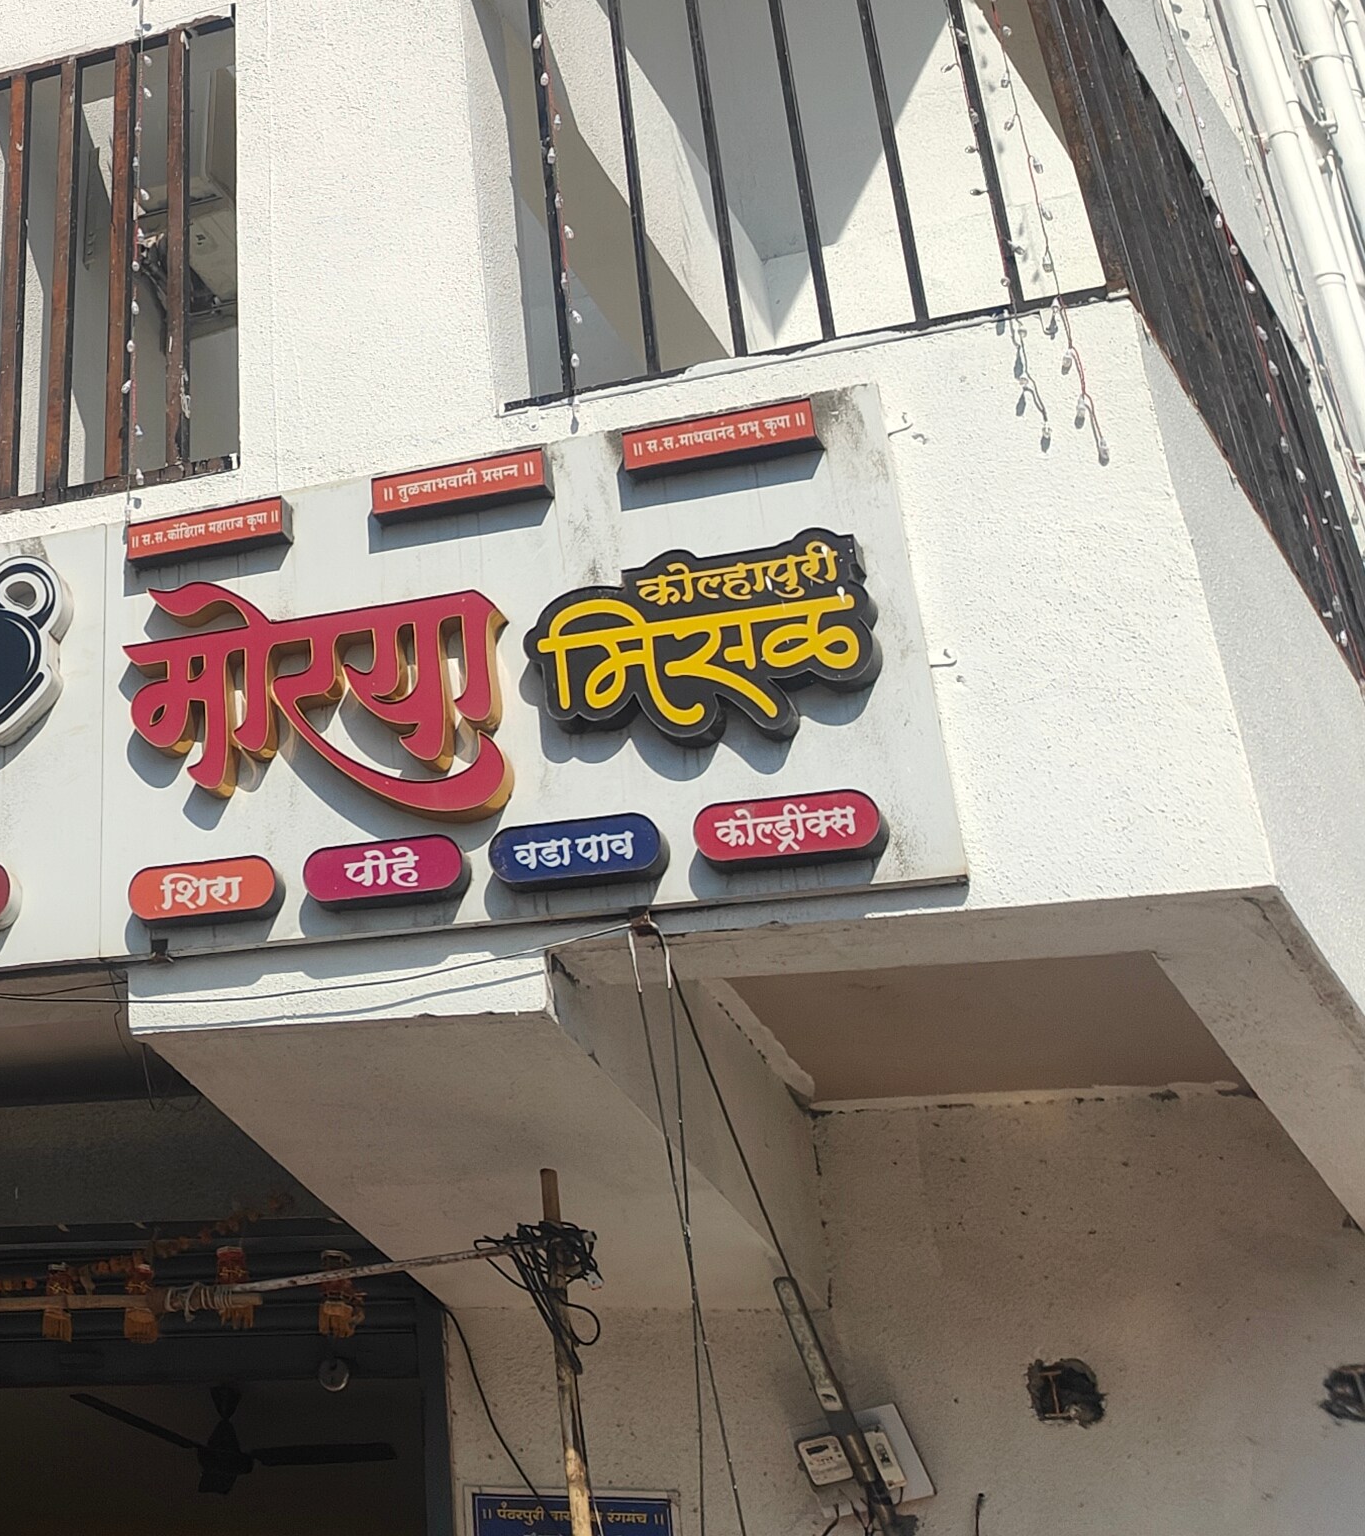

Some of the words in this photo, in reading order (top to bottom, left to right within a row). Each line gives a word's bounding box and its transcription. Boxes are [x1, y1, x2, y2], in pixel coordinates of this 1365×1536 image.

[396, 468, 477, 503] तुळजाभवानी
[480, 464, 519, 483] प्रसन्न
[208, 516, 244, 534] महाराज
[635, 540, 838, 606] कोल्हापुरी
[537, 594, 861, 727] मिसळ
[123, 580, 511, 814] मोरया
[513, 837, 572, 870] वडा
[575, 830, 635, 864] पाव
[160, 872, 243, 911] शिरा
